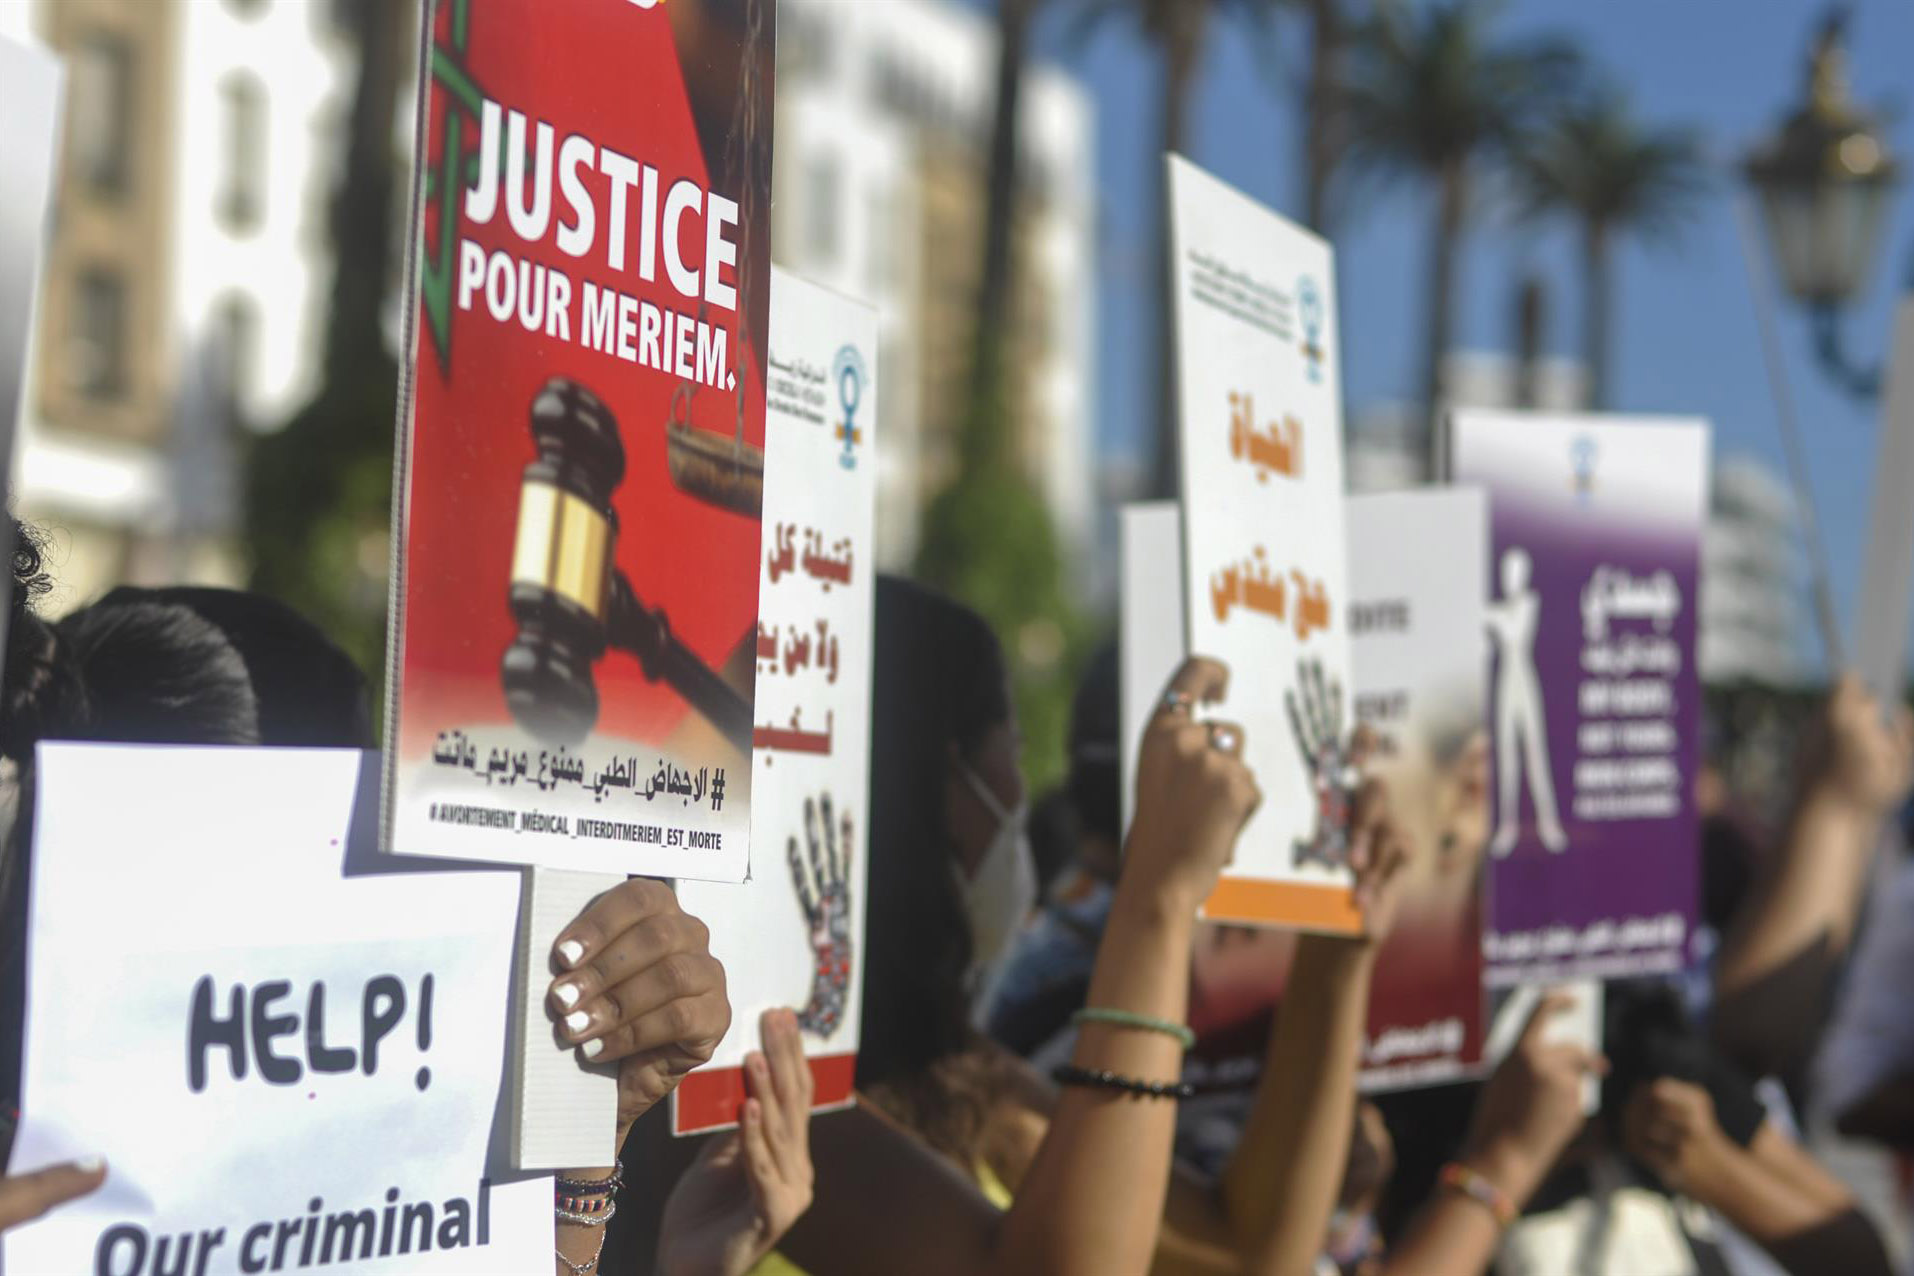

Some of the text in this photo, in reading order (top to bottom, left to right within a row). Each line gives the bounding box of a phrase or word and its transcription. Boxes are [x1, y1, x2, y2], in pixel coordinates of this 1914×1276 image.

[465, 98, 738, 312] JUSTICE
[458, 239, 736, 392] POUR MERIEM.
[187, 972, 435, 1094] HELP!
[95, 1177, 492, 1276] Our criminal
